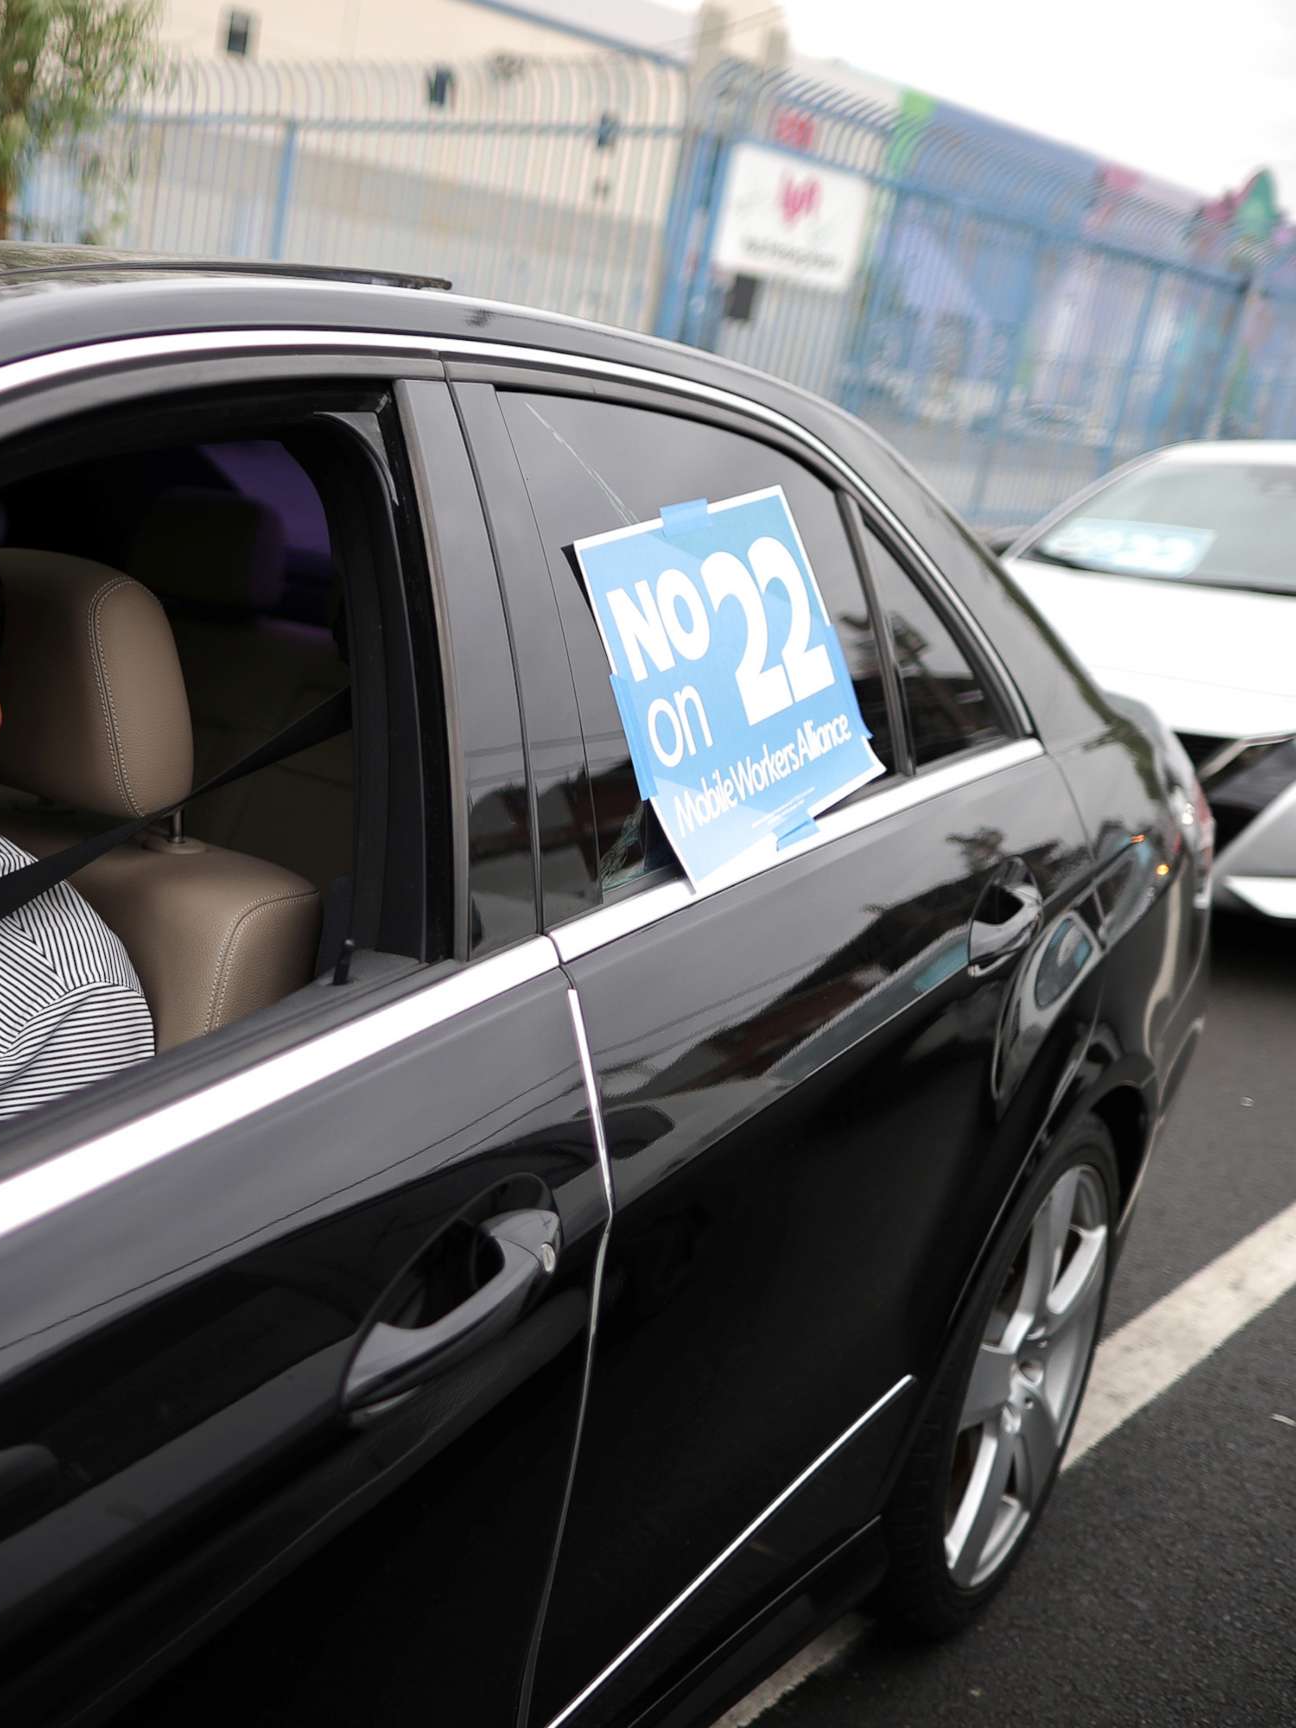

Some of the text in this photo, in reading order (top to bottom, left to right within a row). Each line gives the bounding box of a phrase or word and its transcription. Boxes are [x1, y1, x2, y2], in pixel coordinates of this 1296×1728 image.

[606, 568, 710, 683] NO
[700, 535, 835, 726] 22
[647, 685, 713, 768] on
[673, 769, 738, 838] Mobile
[729, 743, 800, 801] Workers
[796, 713, 852, 767] Alliance
